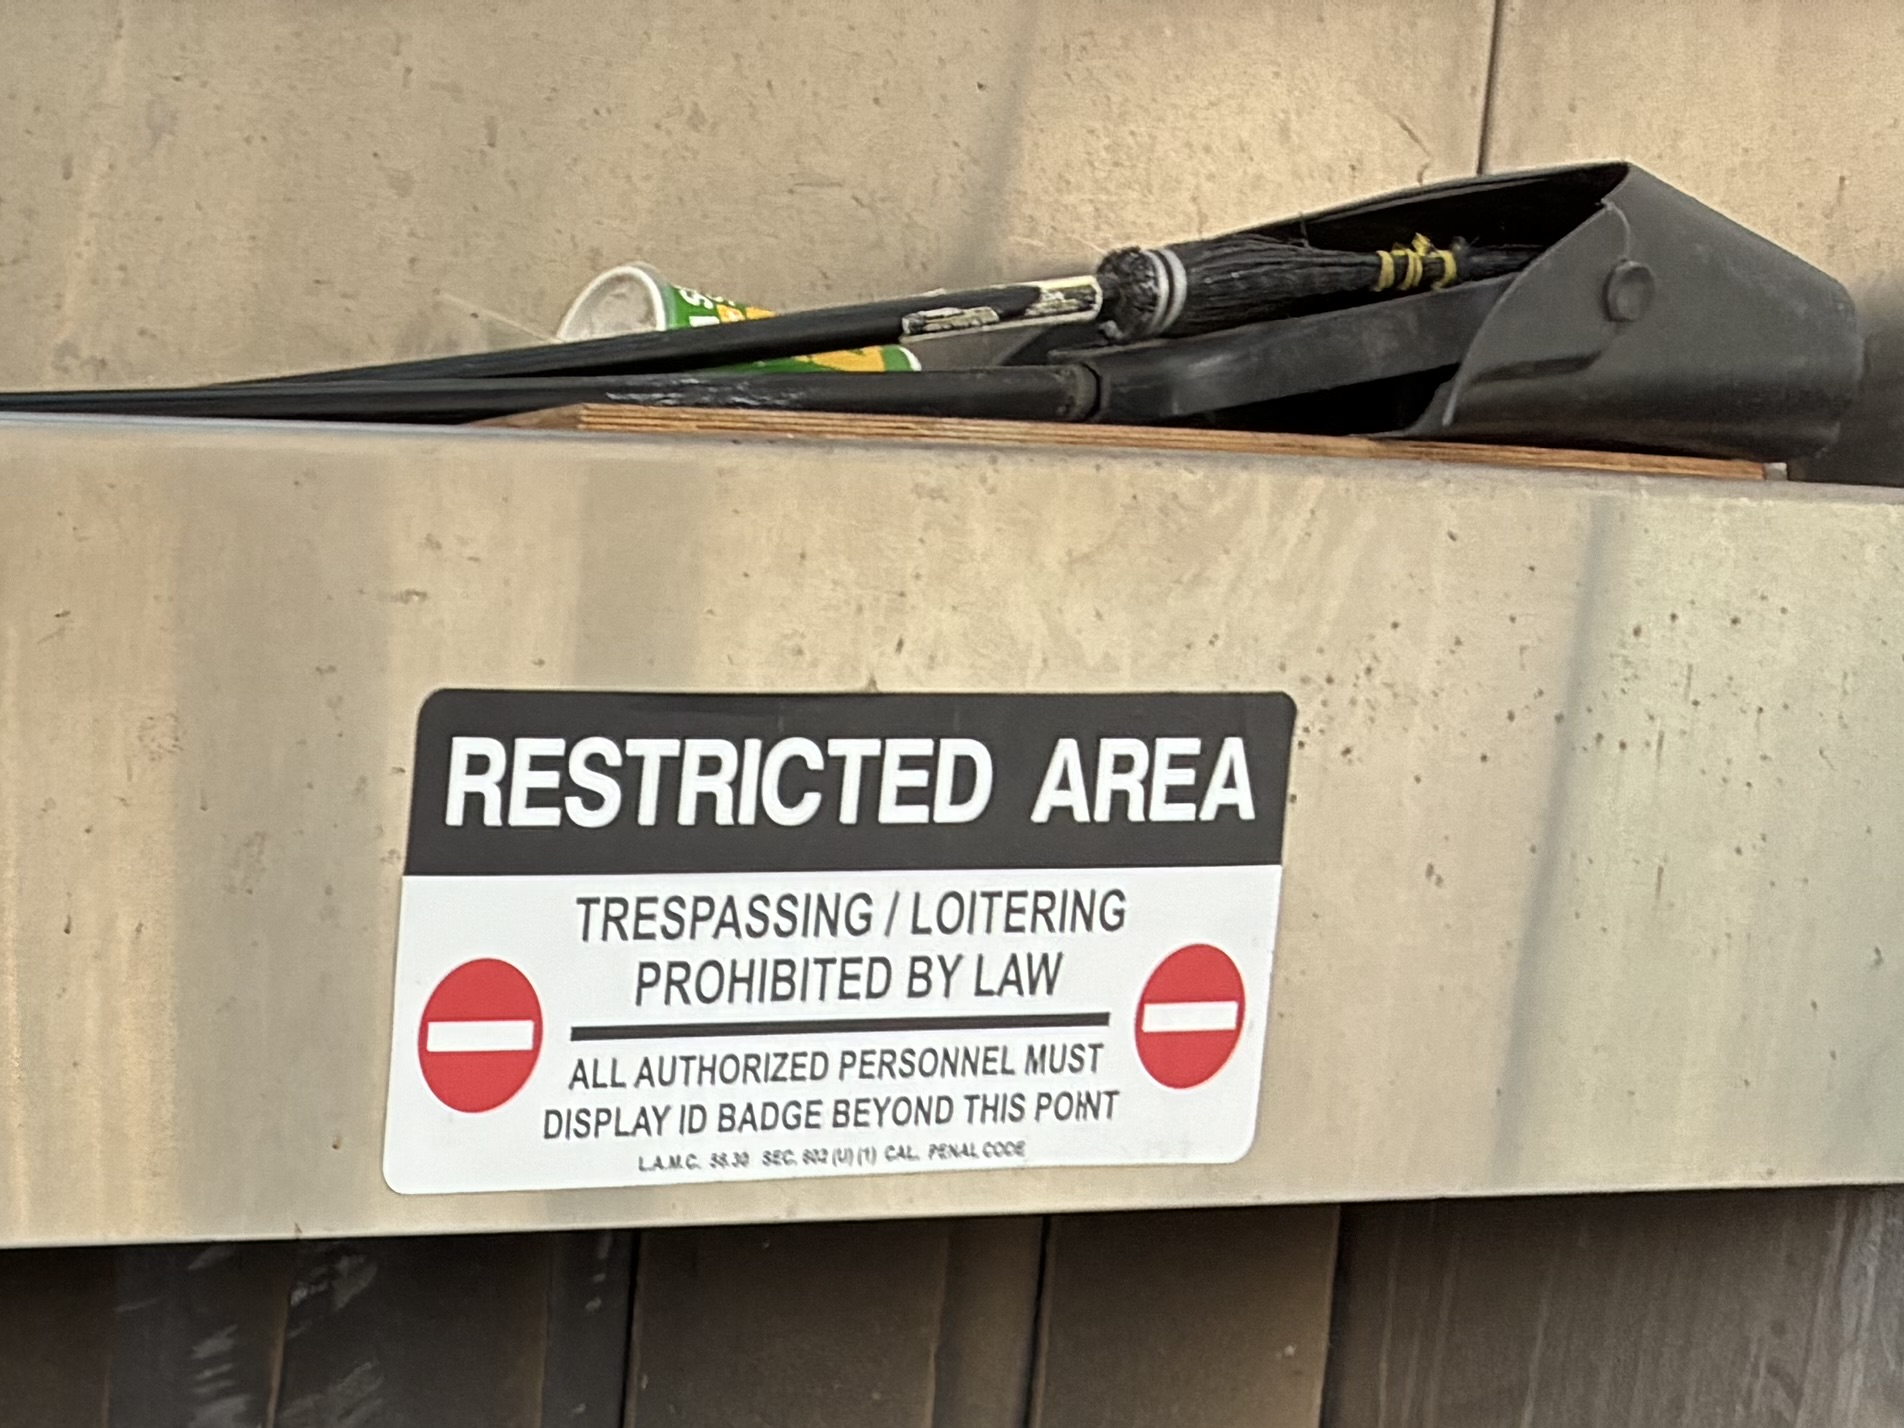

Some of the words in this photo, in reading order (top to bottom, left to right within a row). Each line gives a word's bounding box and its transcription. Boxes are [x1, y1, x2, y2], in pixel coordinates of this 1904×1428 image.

[444, 736, 993, 827] RESTRICTED
[1030, 736, 1256, 823] AREA
[575, 893, 874, 942] TRESPASSING
[884, 891, 901, 938] /
[911, 888, 1127, 936] LOITERING
[635, 955, 892, 1007] PROHIBITED
[907, 954, 965, 999] BY
[973, 951, 1064, 997] LAW
[568, 1057, 627, 1090] ALL
[634, 1051, 829, 1088] AUTHORIZED
[838, 1045, 1015, 1080] PERSONNEL
[1024, 1042, 1104, 1076] MUST
[543, 1105, 672, 1140] DISPLAY
[679, 1104, 707, 1135] ID
[717, 1099, 824, 1133] BADGE
[832, 1094, 954, 1128] BEYOND
[964, 1092, 1026, 1124] THIS
[1034, 1090, 1120, 1122] POINT
[928, 1142, 979, 1160] PENAL
[982, 1140, 1025, 1158] CODE
